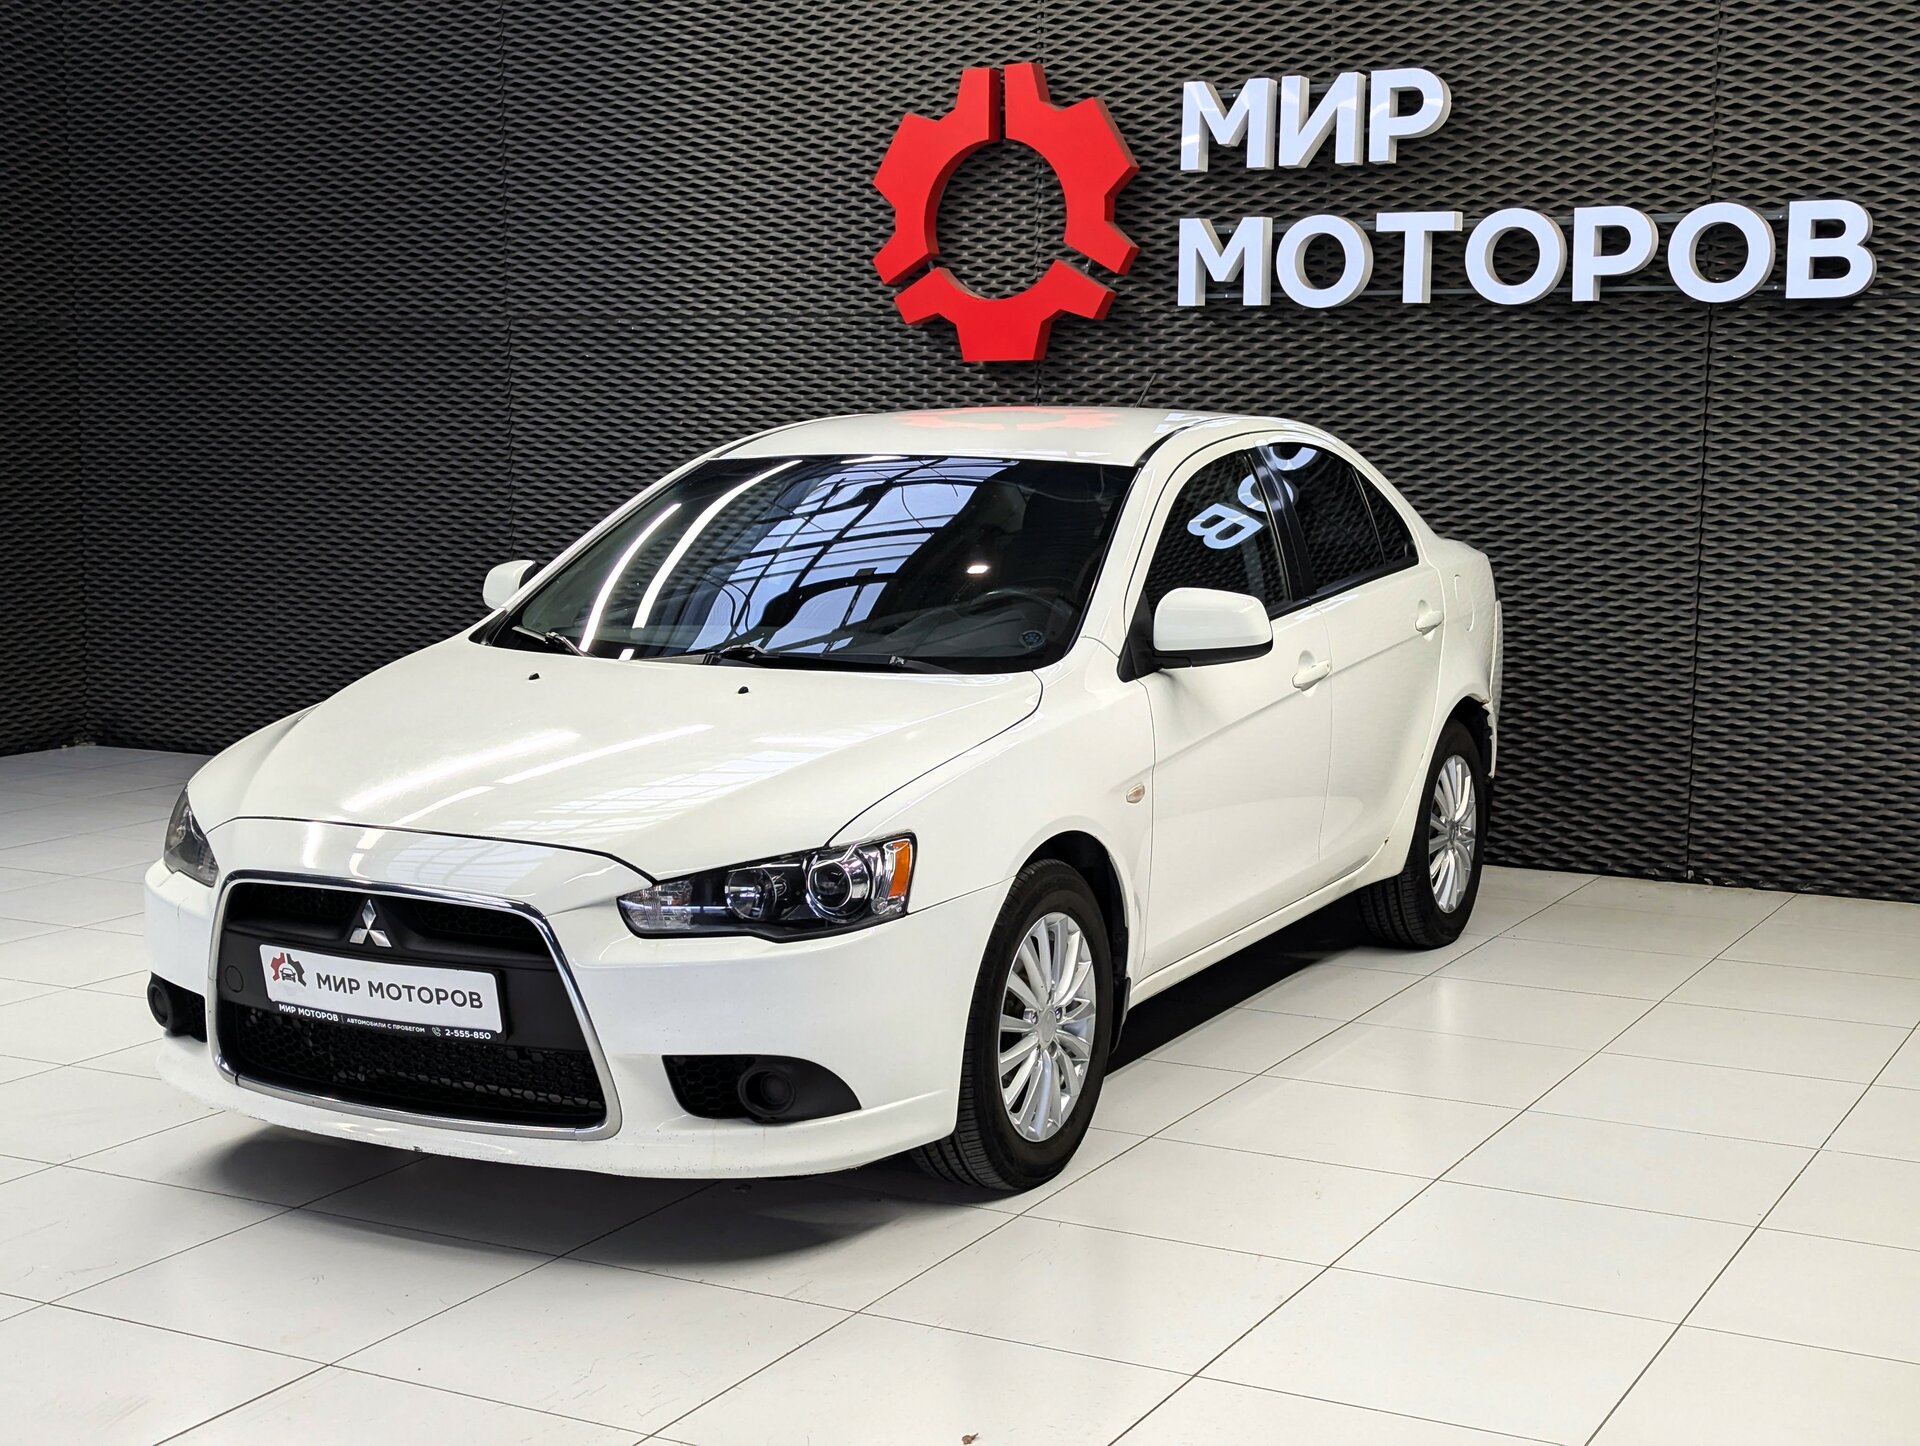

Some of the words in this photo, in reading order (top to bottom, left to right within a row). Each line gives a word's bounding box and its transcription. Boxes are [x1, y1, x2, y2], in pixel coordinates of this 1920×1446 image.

[1179, 67, 1452, 173] МИР
[1177, 199, 1877, 310] МОТОРОВ
[278, 1003, 296, 1014] МИР
[298, 1007, 339, 1022] МОТОРОВ
[346, 1017, 387, 1029] АВТОМОБИЛИ
[392, 1024, 425, 1033] ПРОБЕГОМ
[444, 1028, 491, 1040] 2-555-850
[315, 972, 361, 995] МИР
[368, 980, 484, 1009] МОТОРОВ
